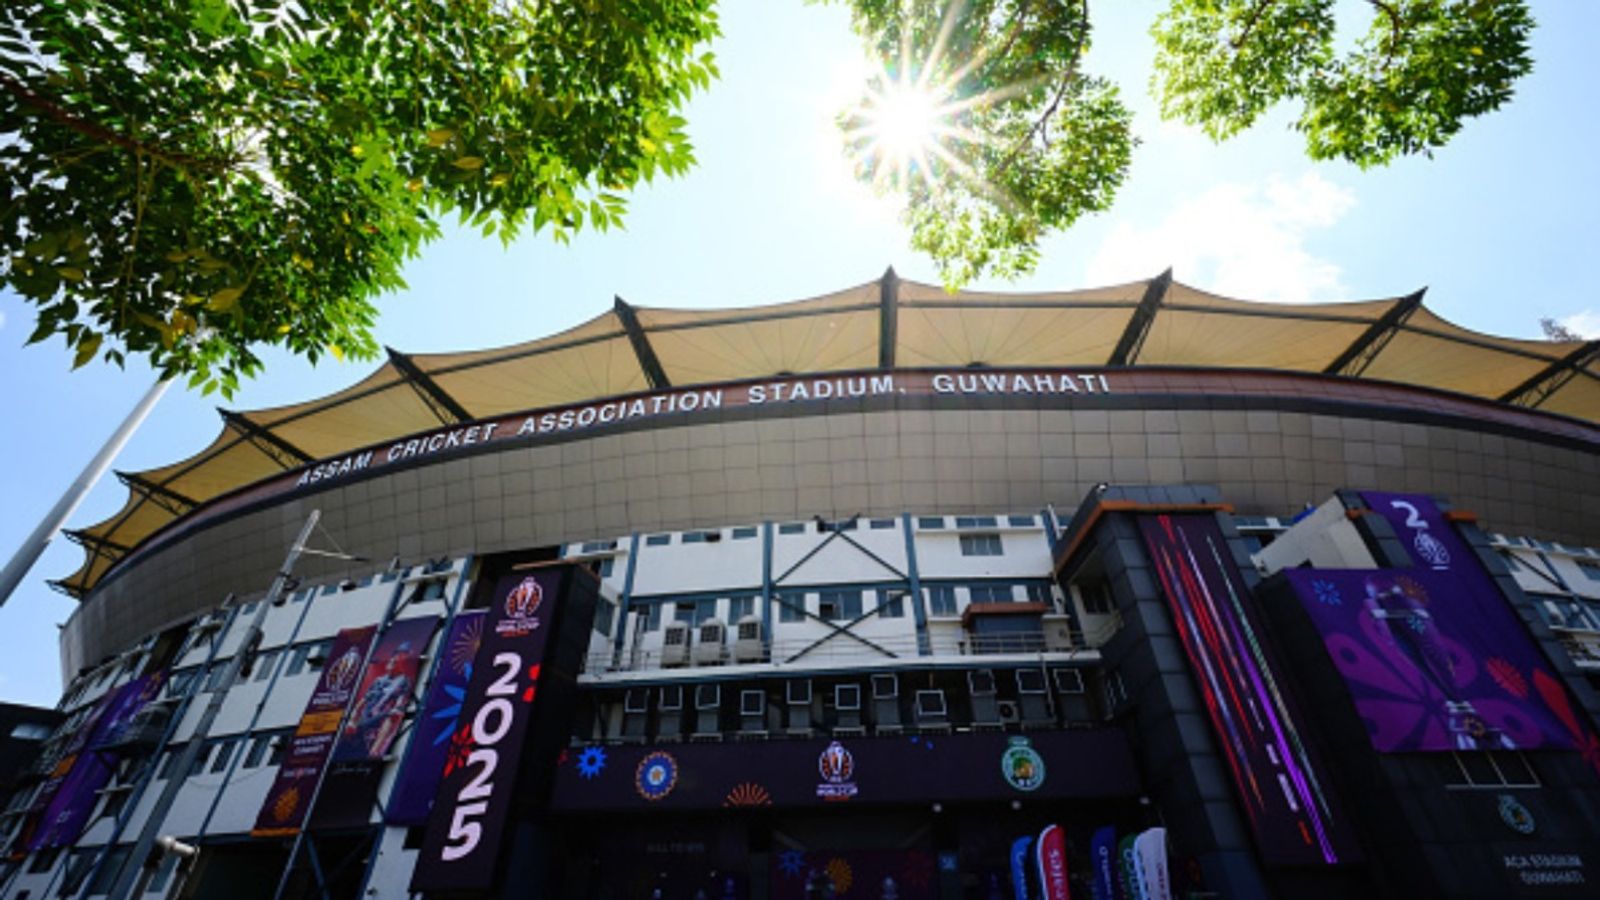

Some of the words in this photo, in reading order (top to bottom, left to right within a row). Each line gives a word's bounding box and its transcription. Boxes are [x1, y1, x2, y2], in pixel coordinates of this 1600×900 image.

[294, 450, 375, 487] ASSAM
[386, 422, 499, 463] CRICKET
[516, 389, 723, 437] ASSOCIATION
[931, 373, 1111, 394] GUWAHATI
[441, 652, 522, 861] 2025
